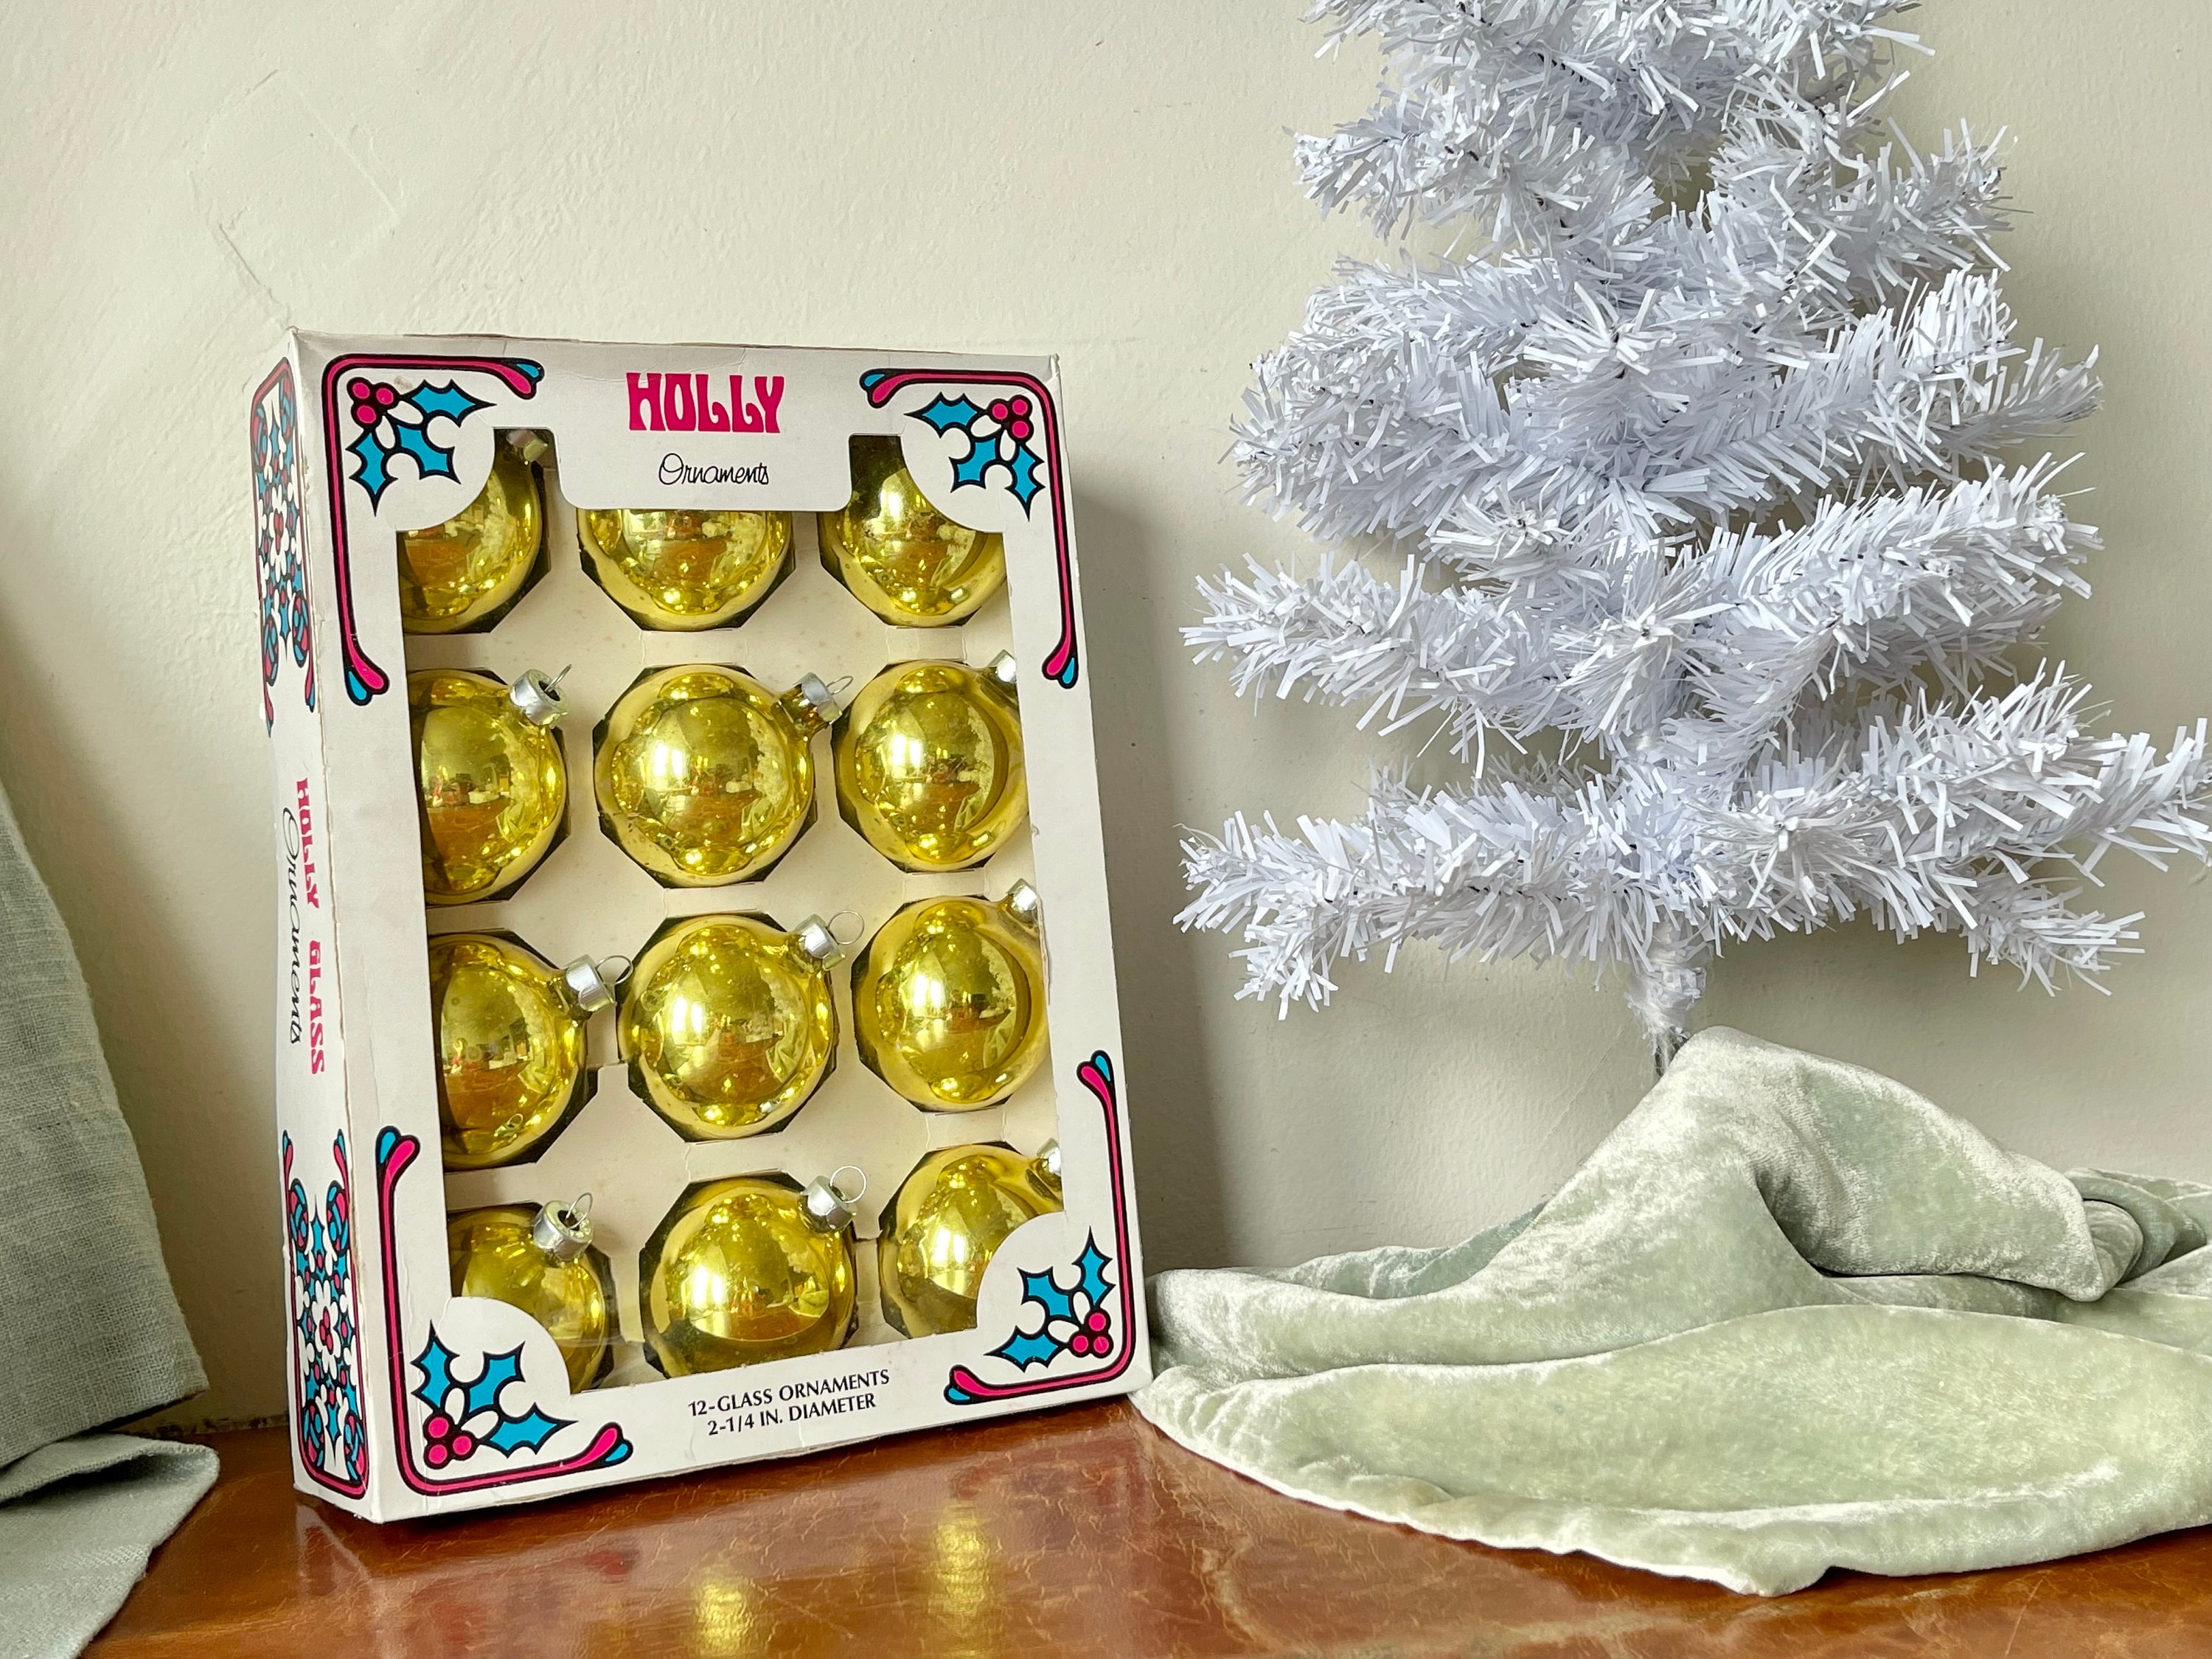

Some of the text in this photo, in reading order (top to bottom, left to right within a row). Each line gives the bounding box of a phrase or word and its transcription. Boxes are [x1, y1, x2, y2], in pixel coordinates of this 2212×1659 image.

[626, 372, 785, 434] HOLLY
[658, 452, 769, 485] Ornaments
[282, 807, 302, 1045] Ornaments
[296, 776, 325, 1075] HOLLY GLASS
[688, 1368, 890, 1417] 12-GLASS ORNAMENTS
[707, 1392, 877, 1436] 2-1/4 IN. DIAMETER
